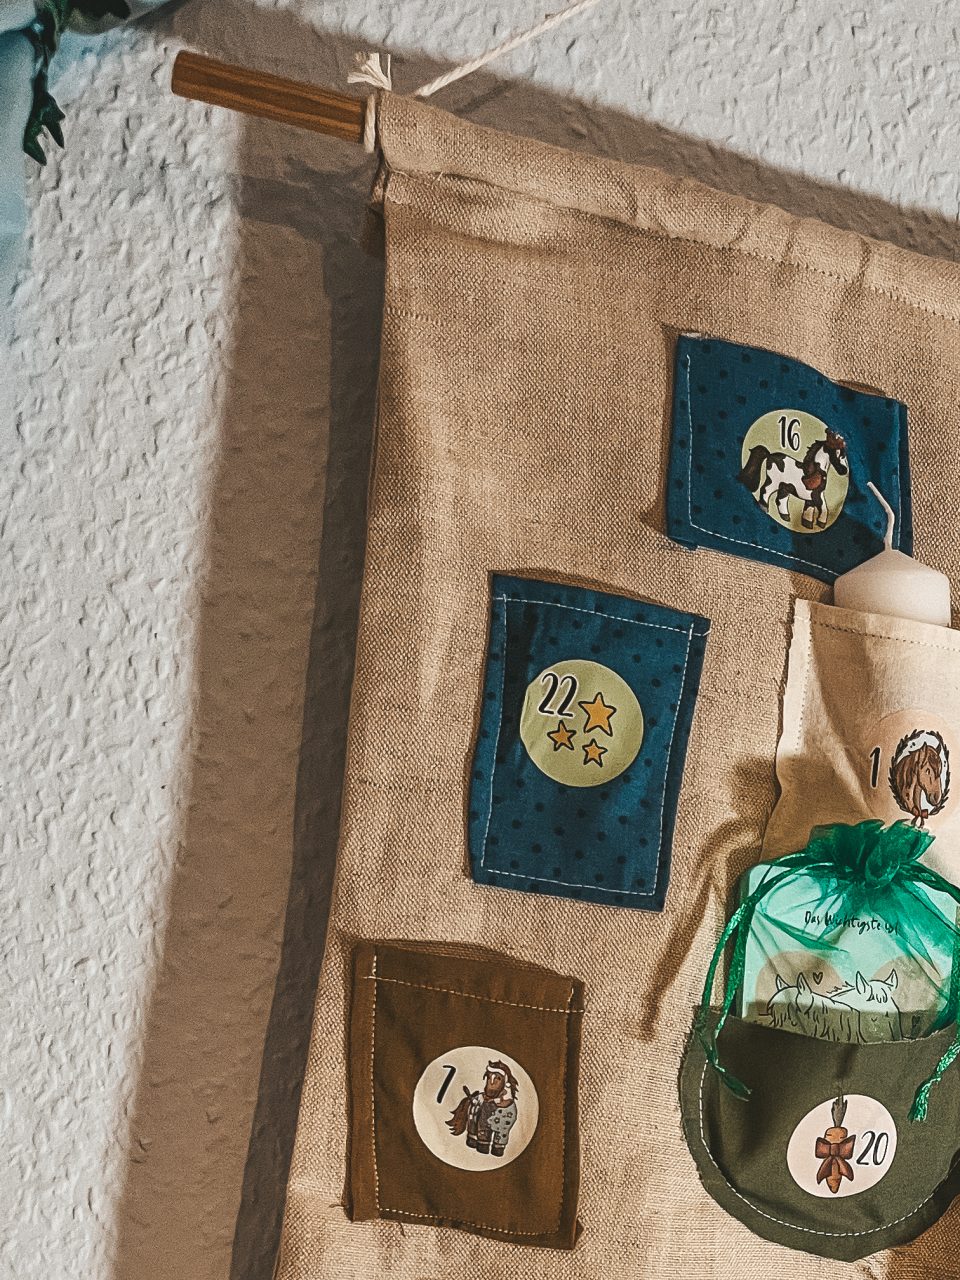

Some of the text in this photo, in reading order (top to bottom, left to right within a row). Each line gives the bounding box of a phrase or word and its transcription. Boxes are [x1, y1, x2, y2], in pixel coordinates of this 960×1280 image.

[778, 416, 801, 451] 16
[538, 673, 577, 718] 22
[870, 748, 880, 787] 1
[804, 910, 820, 925] Das
[824, 911, 881, 935] Wichtigste
[437, 1065, 456, 1103] 7
[857, 1131, 889, 1165] 20
